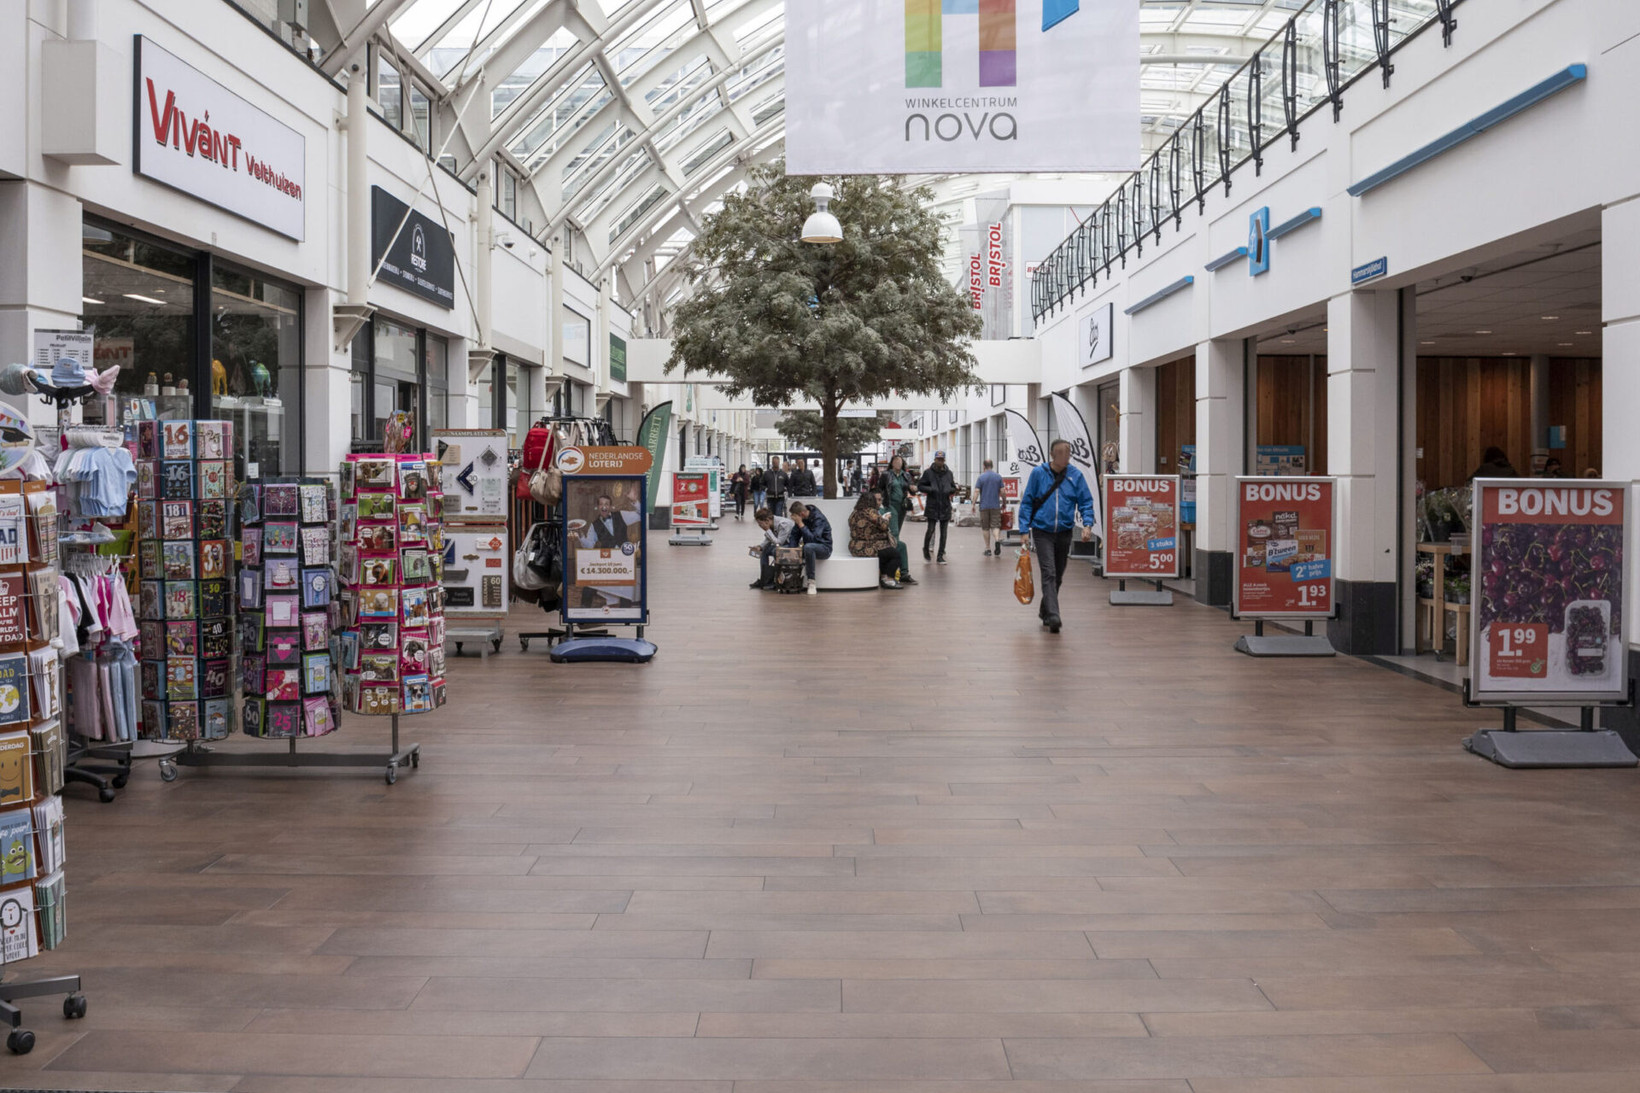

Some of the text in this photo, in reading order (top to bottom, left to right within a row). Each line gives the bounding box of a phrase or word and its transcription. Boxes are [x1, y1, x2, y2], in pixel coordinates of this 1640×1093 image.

[905, 97, 1018, 109] WINKELCENTRUM
[905, 112, 1018, 142] nova
[245, 151, 302, 201] Velthuizen
[164, 424, 190, 446] 16
[588, 452, 644, 461] NEDERLANDSE
[588, 460, 623, 468] LOTERIJ
[1113, 479, 1170, 493] BONUS
[1245, 483, 1321, 501] BONUS
[1497, 488, 1613, 516] BONUS
[1156, 539, 1174, 547] stuks
[1268, 544, 1297, 556] B'tween
[5, 633, 24, 642] DAD
[273, 712, 291, 731] 25
